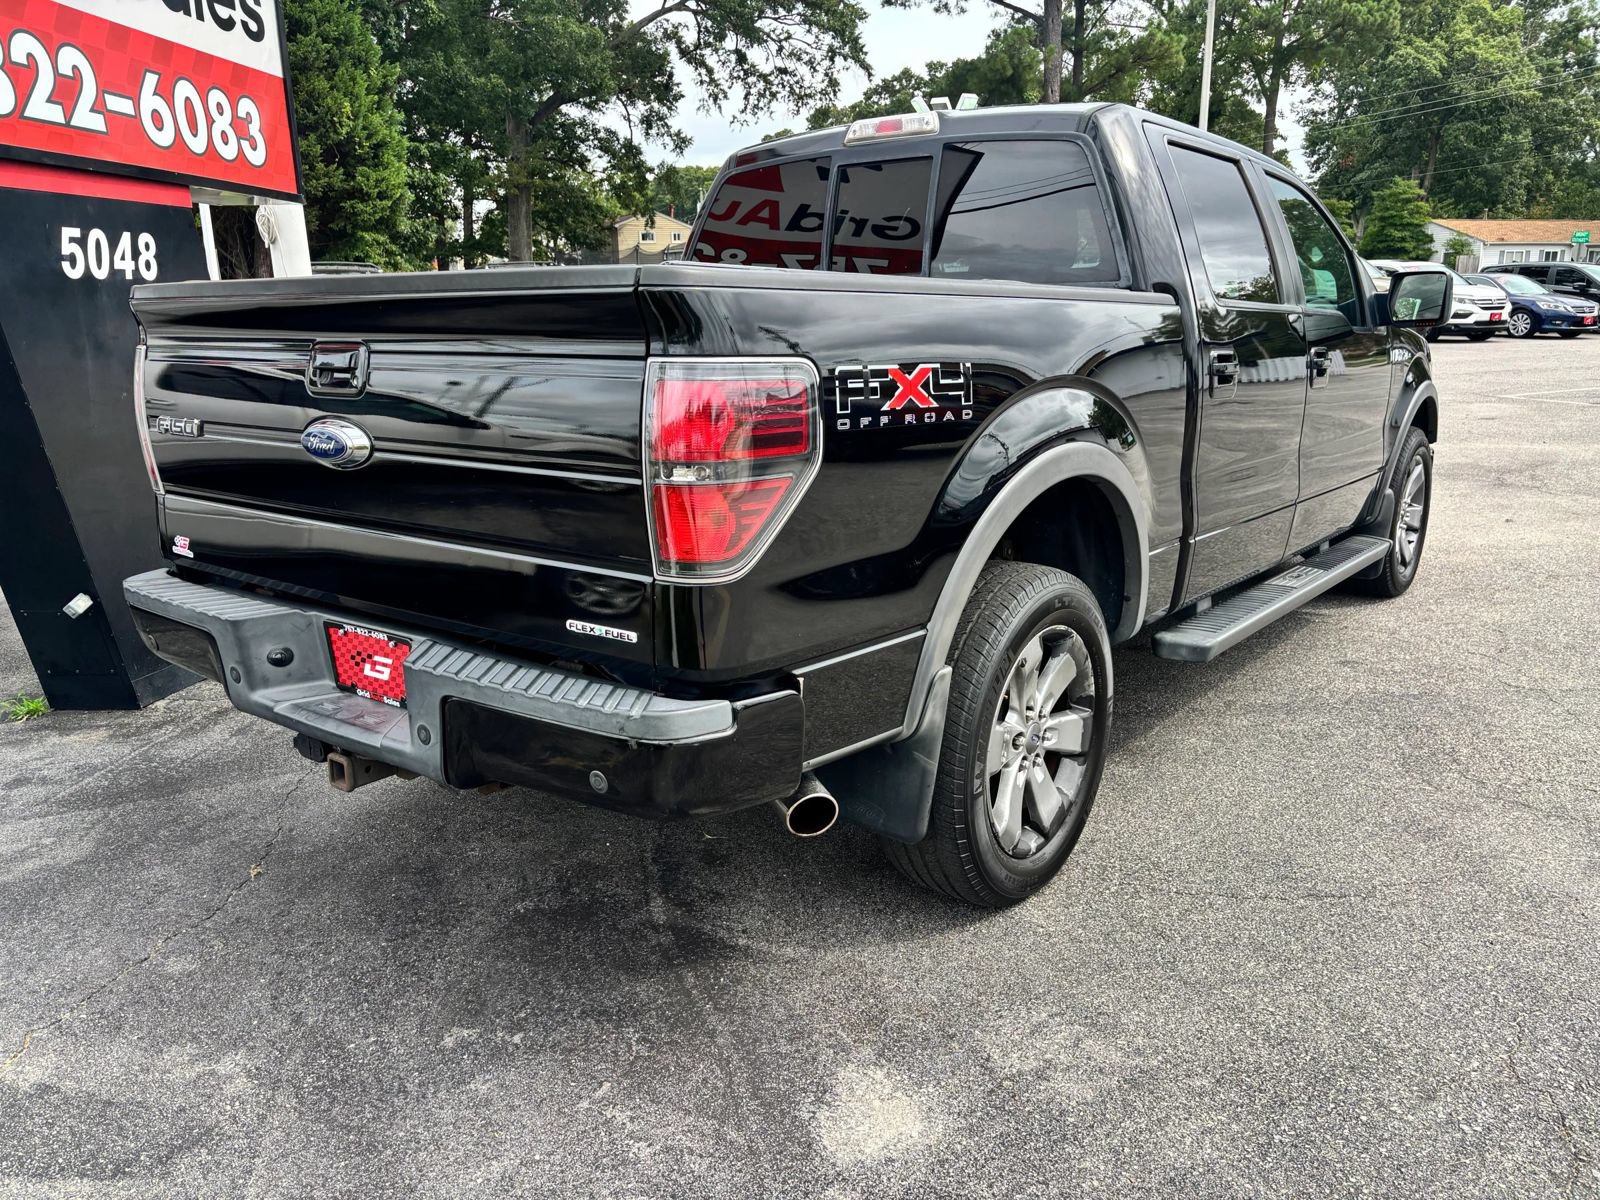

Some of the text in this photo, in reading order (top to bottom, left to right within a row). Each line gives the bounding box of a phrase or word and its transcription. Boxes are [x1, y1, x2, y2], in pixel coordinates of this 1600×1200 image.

[61, 227, 158, 281] 5048
[835, 363, 973, 414] FX4
[837, 410, 973, 430] OFF ROAD
[307, 432, 337, 455] Ford
[568, 622, 634, 643] FLEX FUEL
